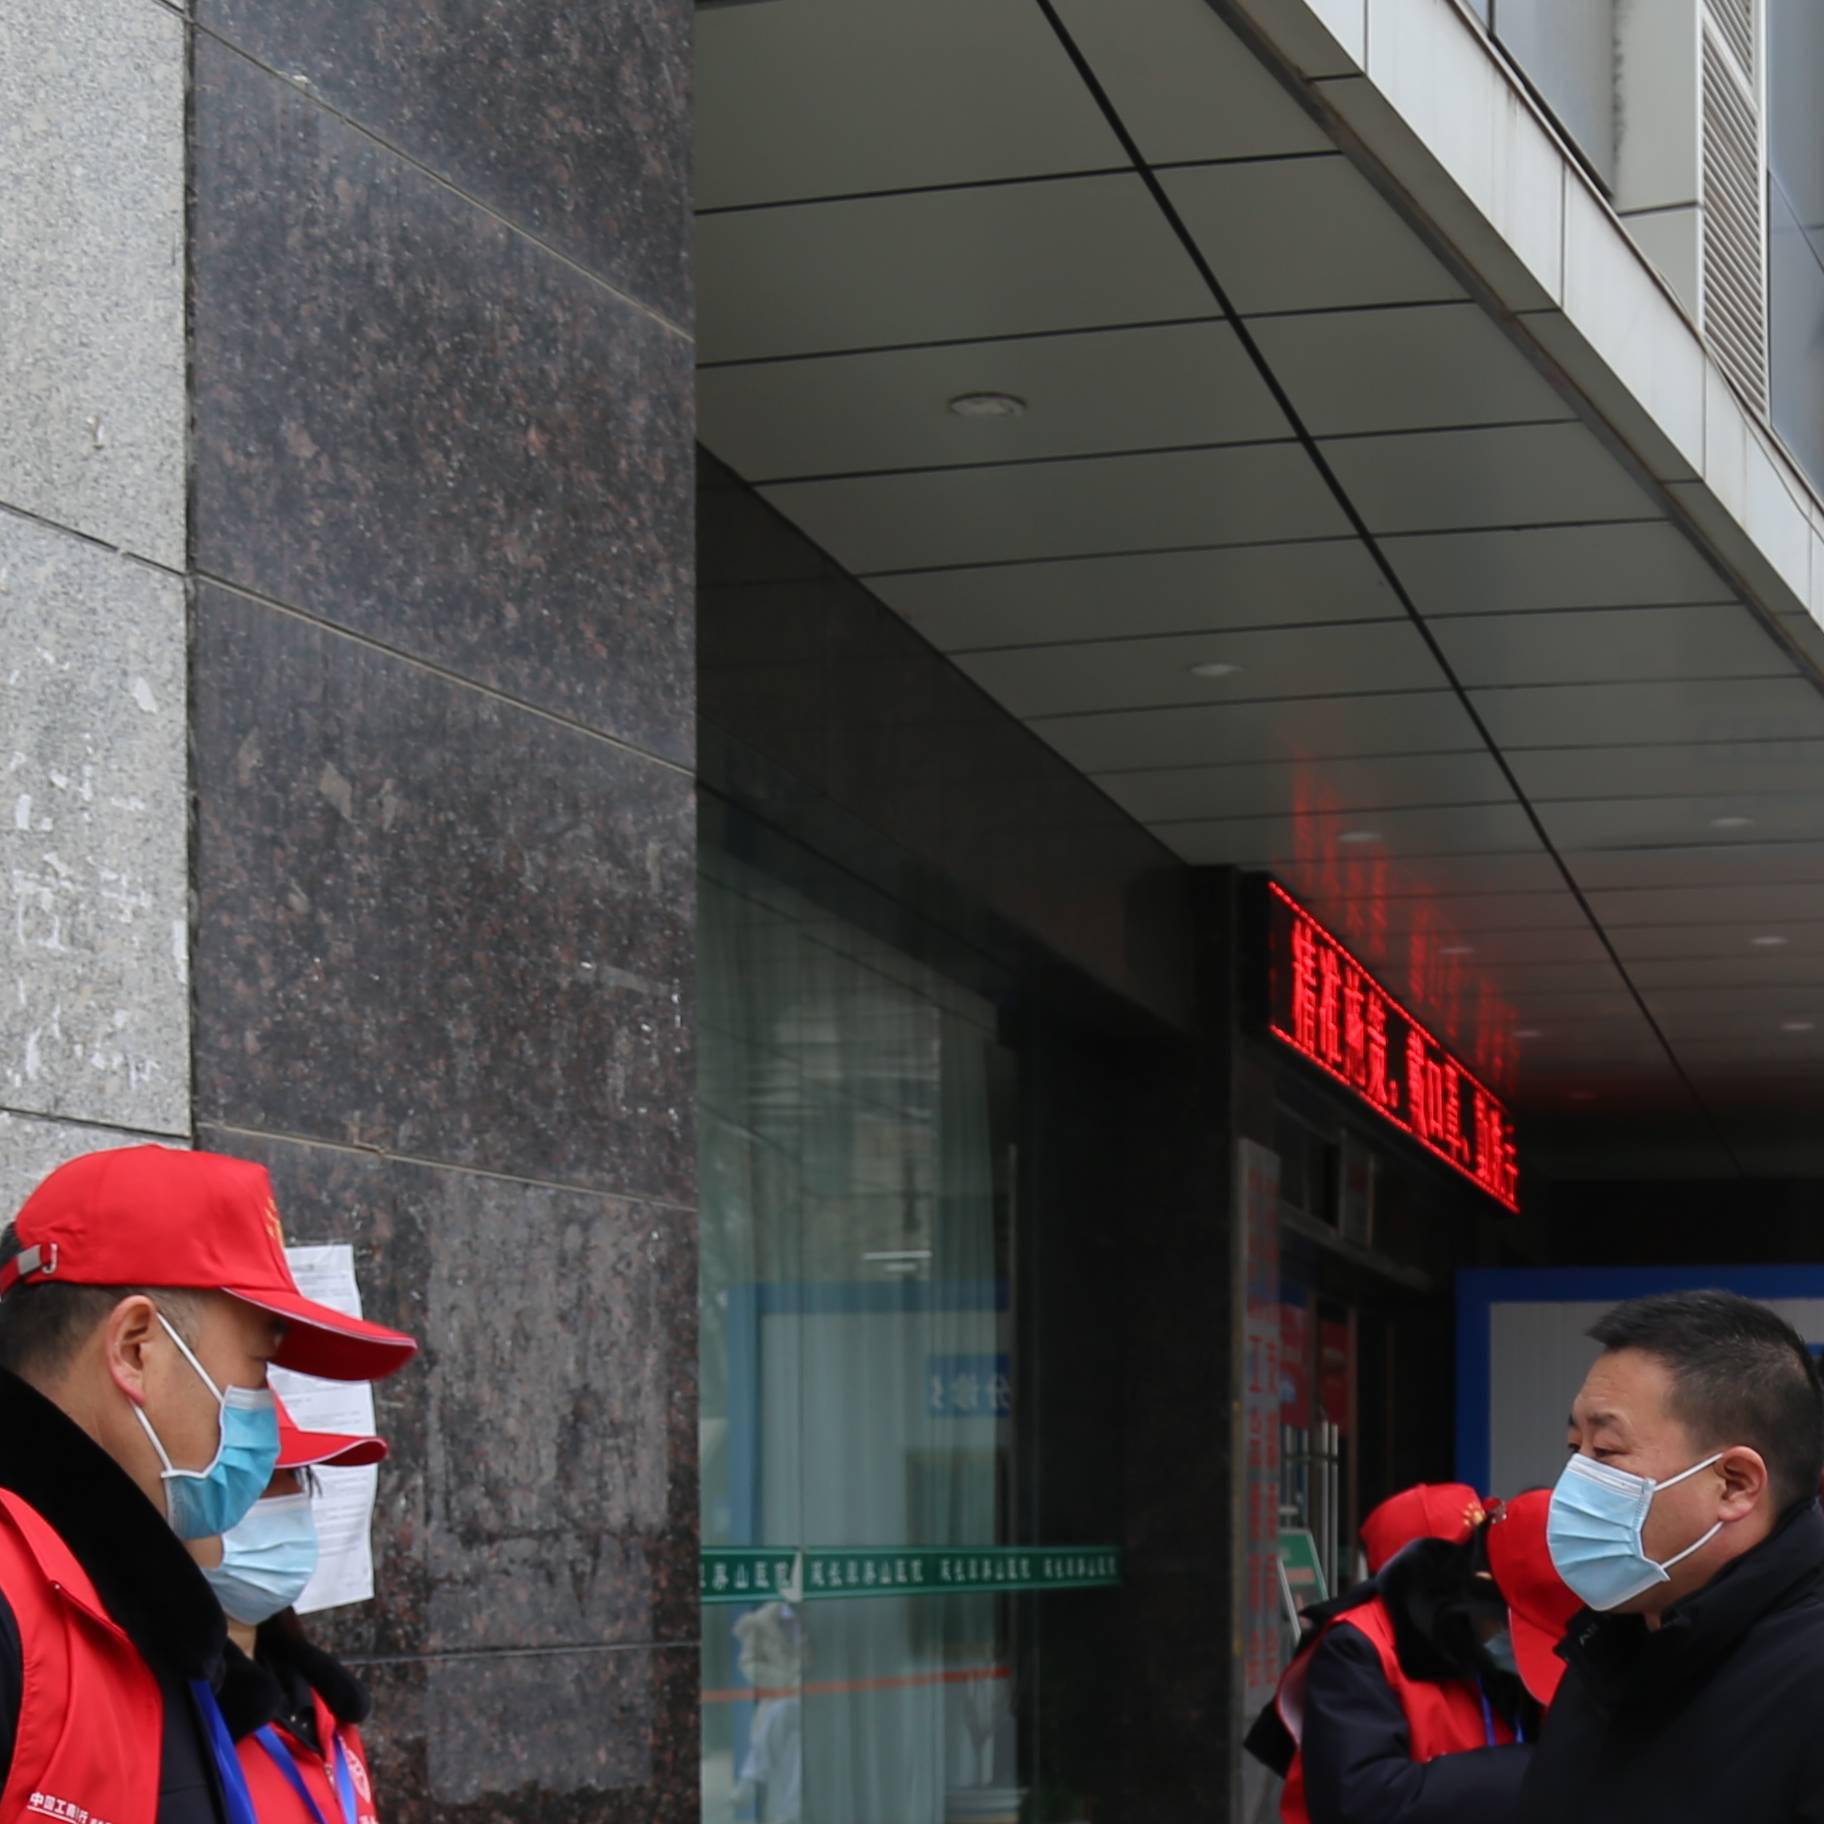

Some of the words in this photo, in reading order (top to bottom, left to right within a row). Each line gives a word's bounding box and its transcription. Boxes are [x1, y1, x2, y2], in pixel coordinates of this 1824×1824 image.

[29, 1791, 89, 1824] 中国工商行
